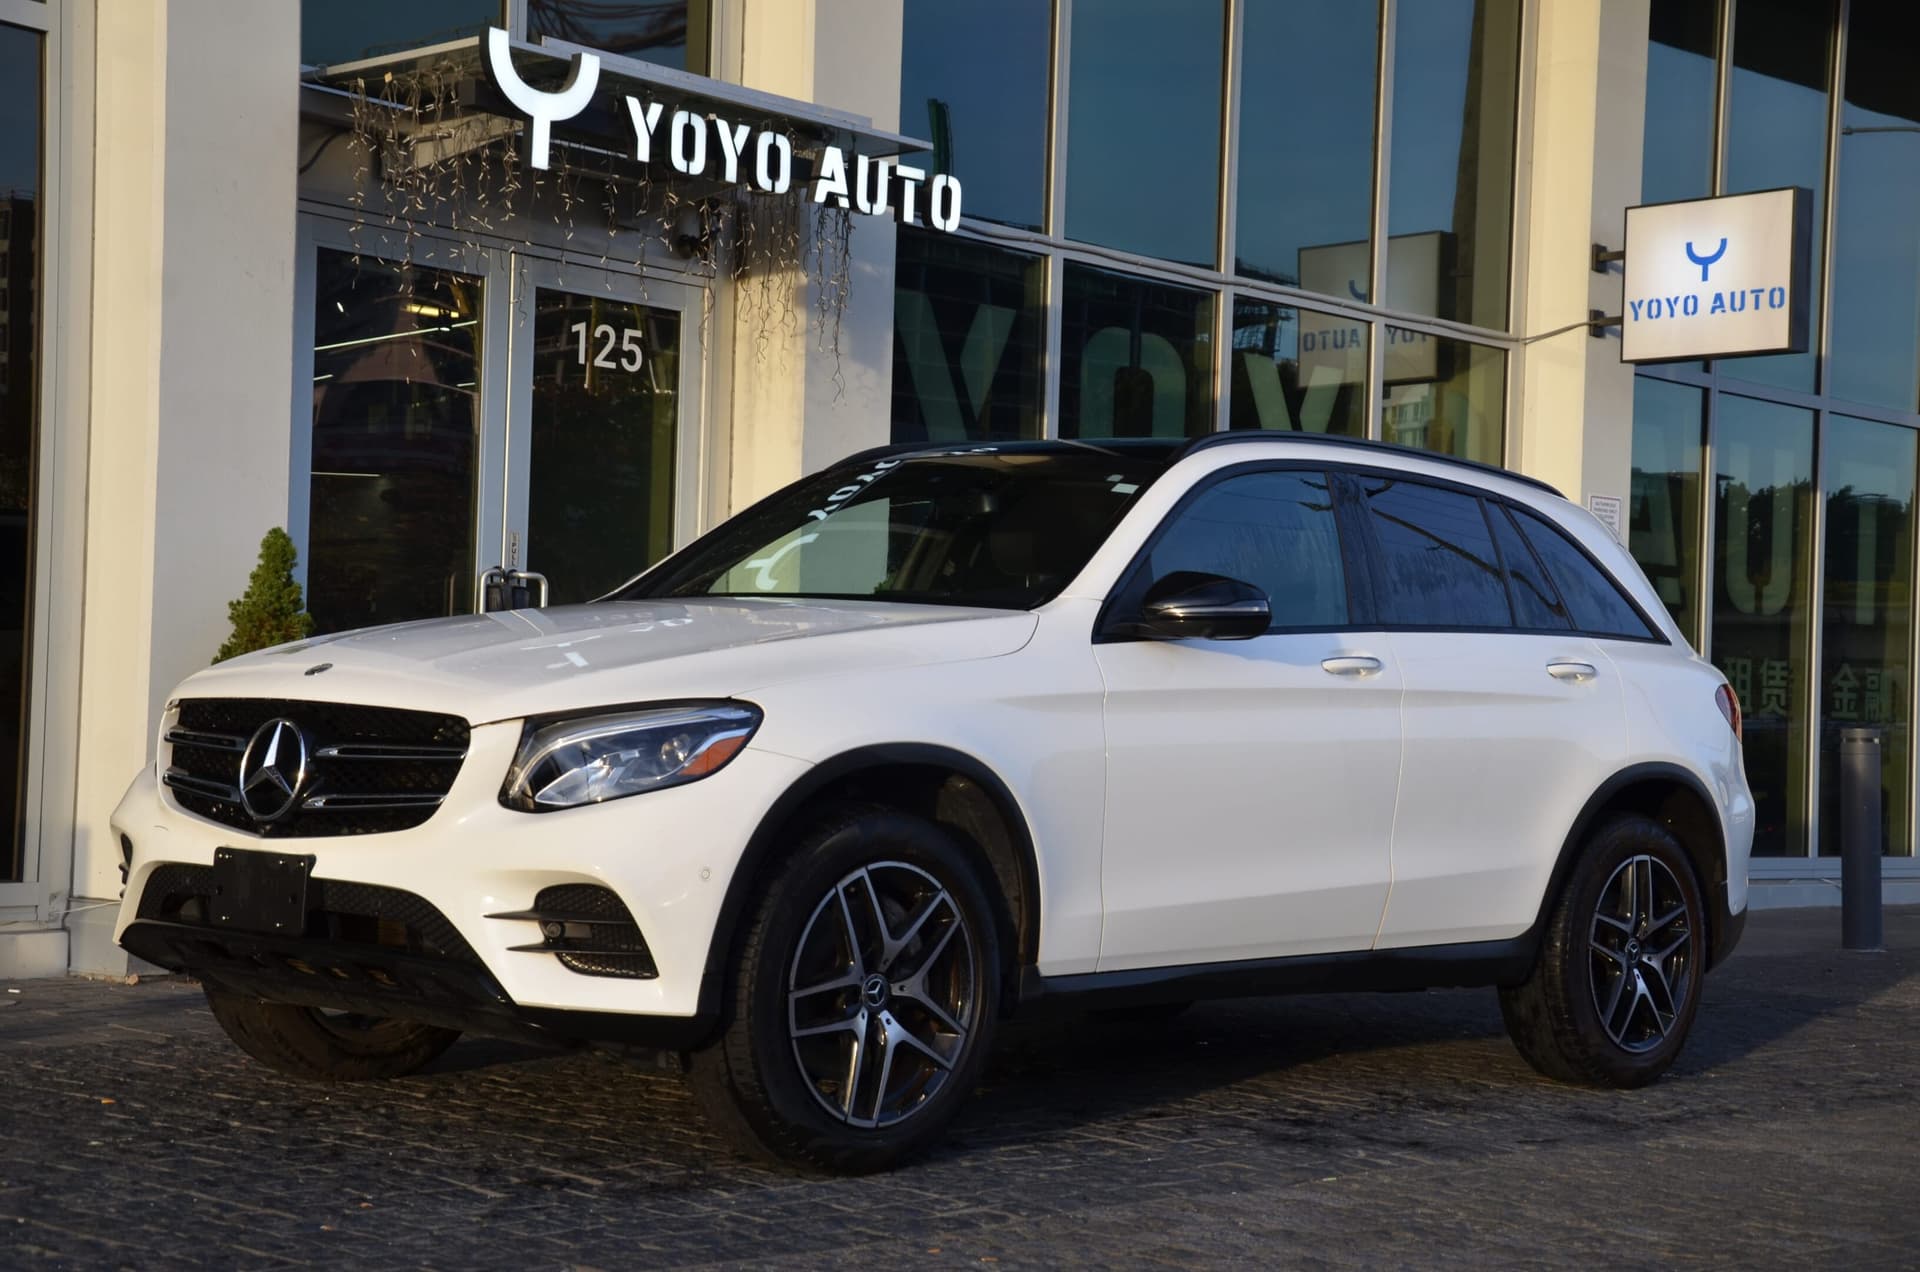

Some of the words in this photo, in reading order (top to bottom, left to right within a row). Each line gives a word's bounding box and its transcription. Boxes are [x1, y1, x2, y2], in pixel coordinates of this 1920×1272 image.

[625, 95, 792, 194] YOYO
[814, 145, 962, 233] AUTO
[1629, 294, 1699, 322] YOYO
[1710, 286, 1786, 315] AUTO
[571, 321, 643, 373] 125
